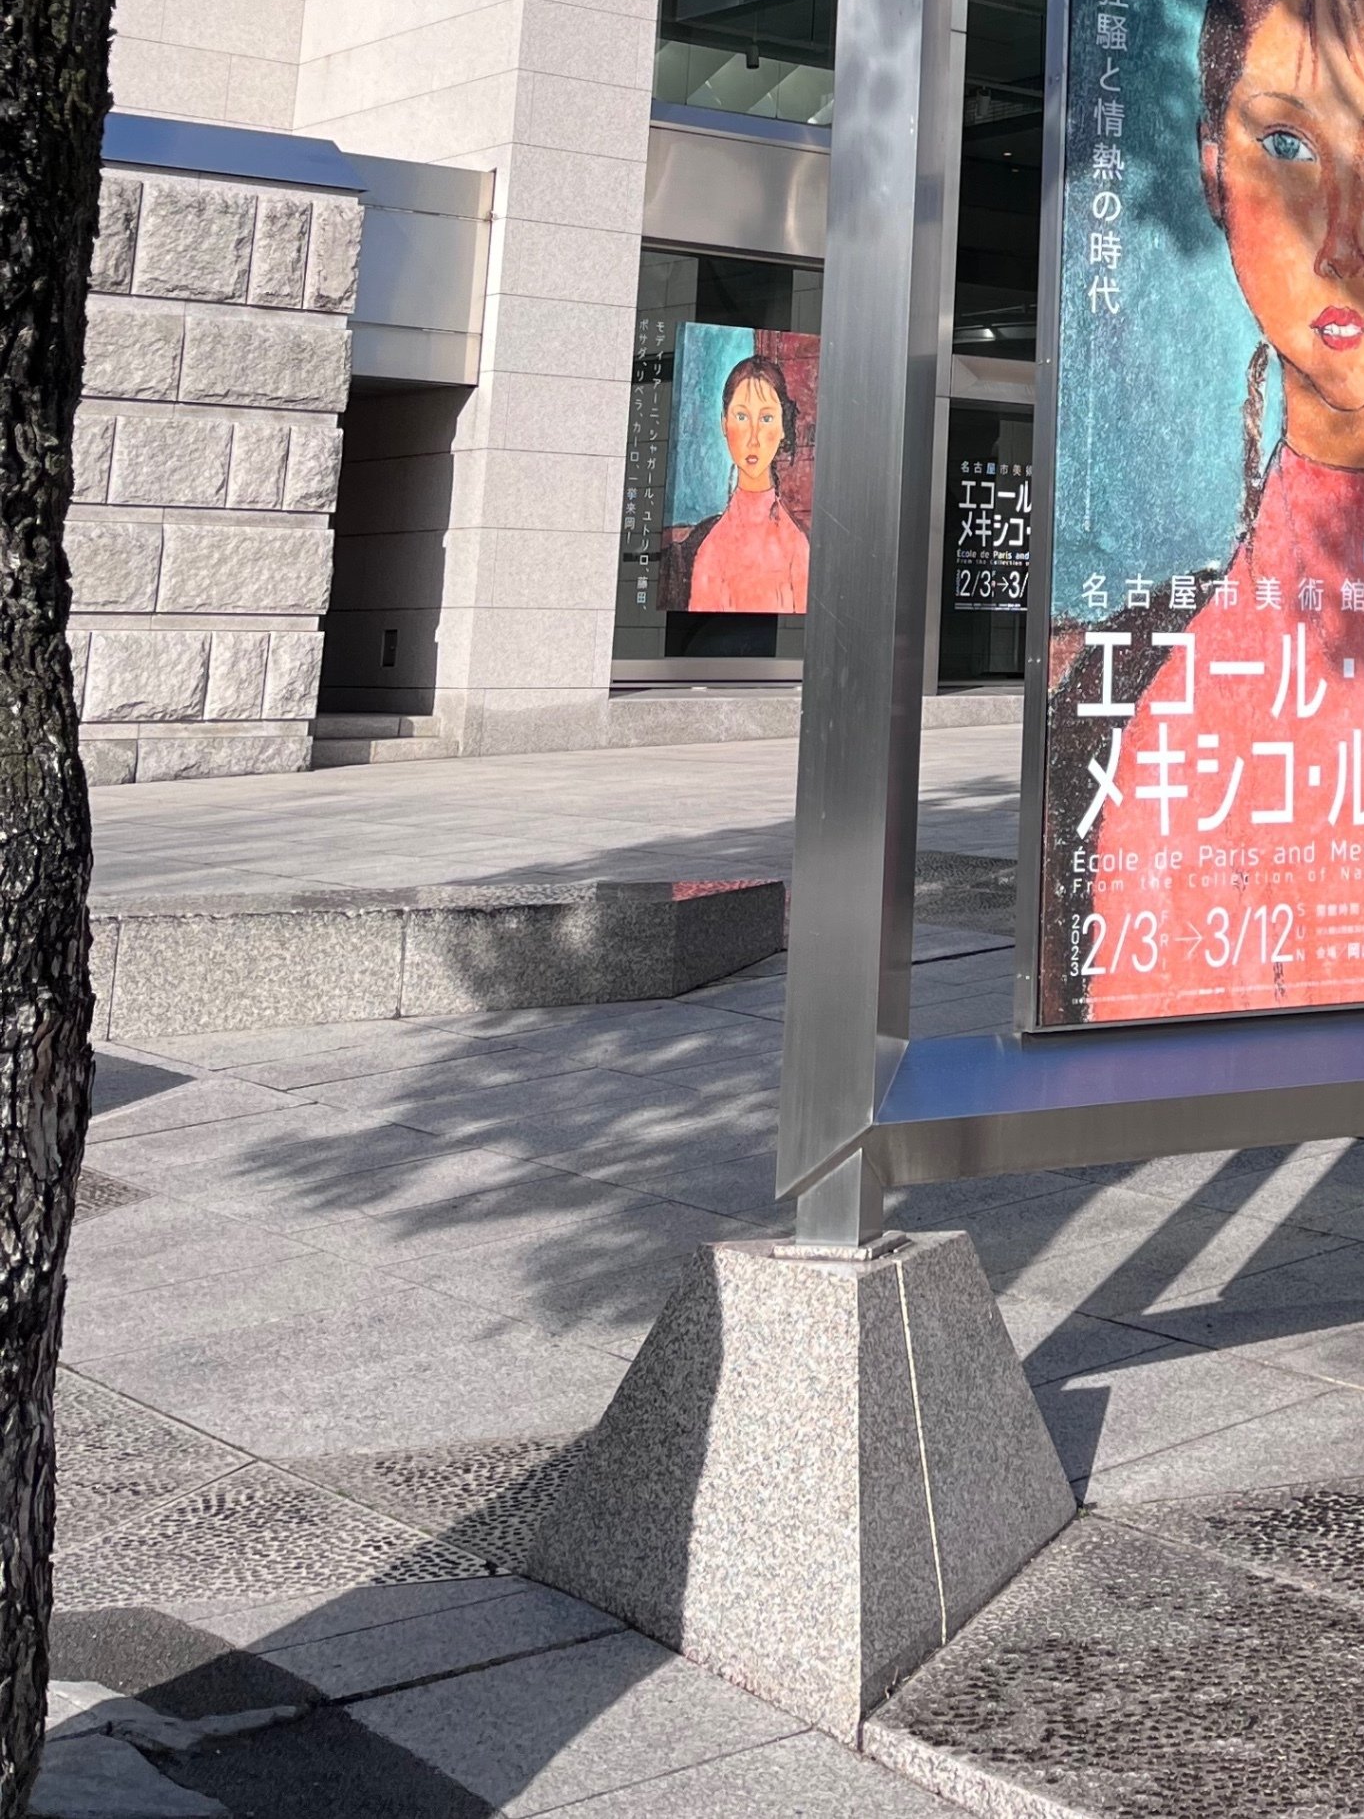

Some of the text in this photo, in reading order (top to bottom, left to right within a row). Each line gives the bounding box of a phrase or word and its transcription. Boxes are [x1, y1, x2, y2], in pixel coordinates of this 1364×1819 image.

[993, 550, 1012, 560] Paris
[1015, 551, 1029, 560] and
[1072, 846, 1139, 873] École
[1154, 848, 1183, 870] de
[1199, 844, 1260, 867] Paris
[1273, 841, 1316, 864] and
[1072, 878, 1125, 894] From
[1140, 875, 1173, 889] the
[1188, 871, 1299, 889] Collection
[1308, 868, 1327, 882] of
[1070, 913, 1081, 978] 2023
[1080, 909, 1158, 977] 2/3
[1204, 902, 1295, 968] 3/12
